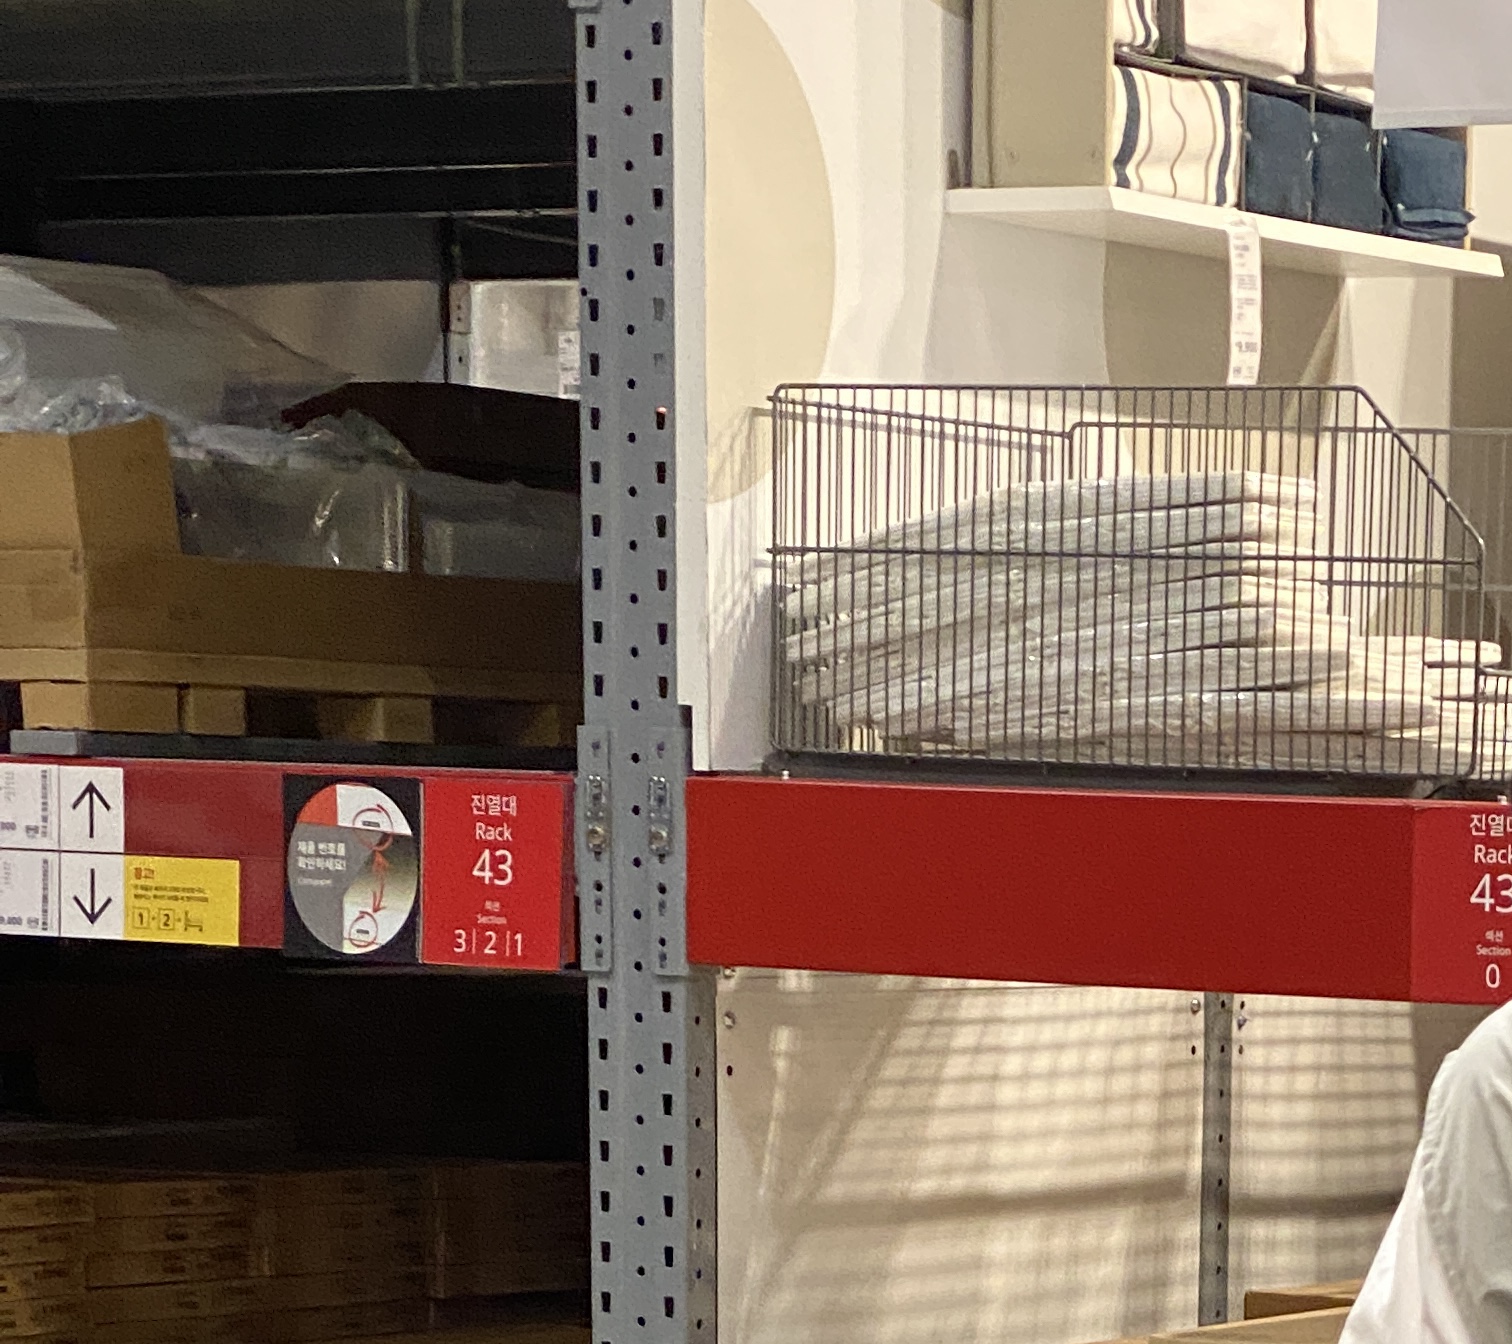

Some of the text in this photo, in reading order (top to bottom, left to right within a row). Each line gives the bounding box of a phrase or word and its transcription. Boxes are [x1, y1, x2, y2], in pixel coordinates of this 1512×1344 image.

[471, 794, 517, 817] 진열대
[475, 822, 512, 841] Rack
[472, 849, 513, 886] 43
[453, 929, 523, 956] 3 2 1
[1475, 944, 1511, 956] Section
[1485, 963, 1500, 989] 0
